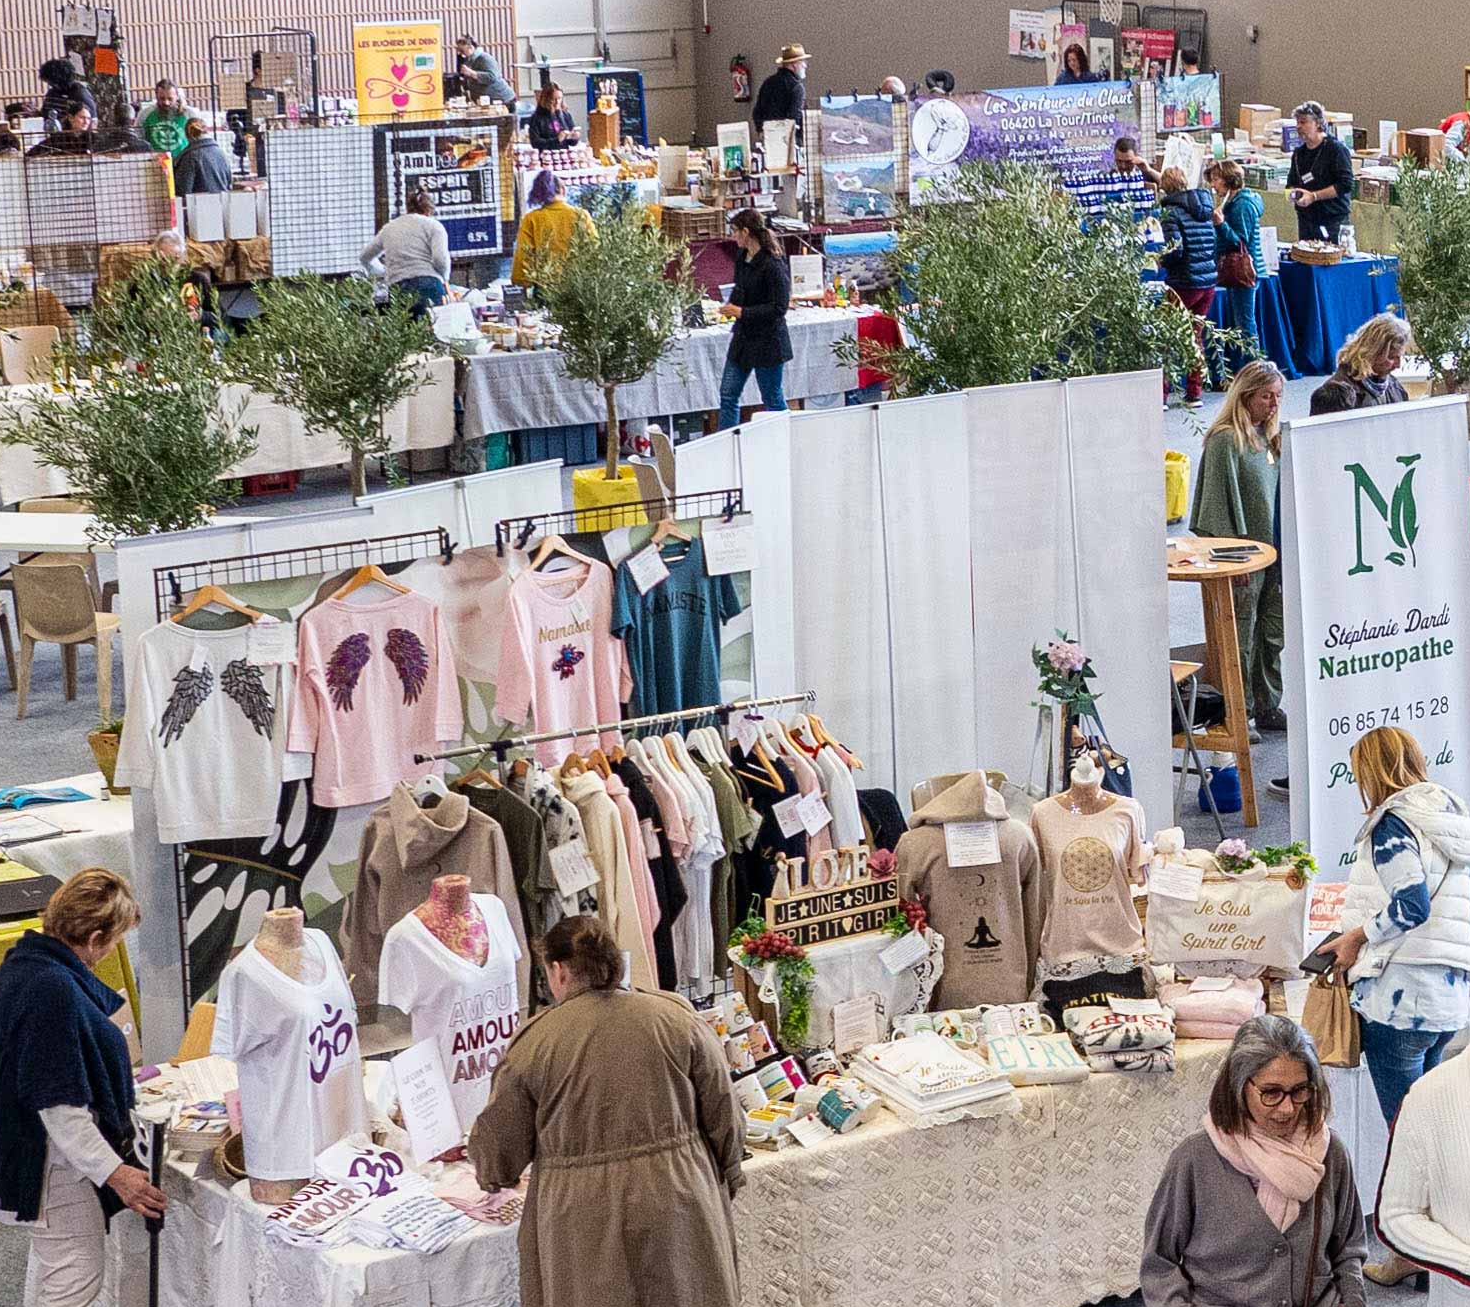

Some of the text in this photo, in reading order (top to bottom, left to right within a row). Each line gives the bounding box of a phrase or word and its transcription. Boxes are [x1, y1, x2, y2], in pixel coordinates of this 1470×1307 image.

[358, 38, 417, 48] LES DE
[983, 88, 1133, 115] Les Senteurs du Claut
[1002, 113, 1115, 130] 06420 La Tour/Tinée
[1004, 128, 1114, 143] Alpes-Maritimes
[418, 173, 469, 189] ESPRIT
[444, 189, 472, 203] SUD
[1325, 603, 1451, 655] Stéphanie Dardi
[1318, 636, 1455, 680] Naturopathe
[1329, 696, 1449, 737] 06 85 74 15 28
[1435, 740, 1454, 766] de
[789, 845, 871, 895] LOVE
[778, 881, 897, 923] JE UNE SUIS
[1194, 899, 1251, 918] Je Suis
[1208, 921, 1236, 933] une
[1181, 931, 1265, 953] Spirit Girl
